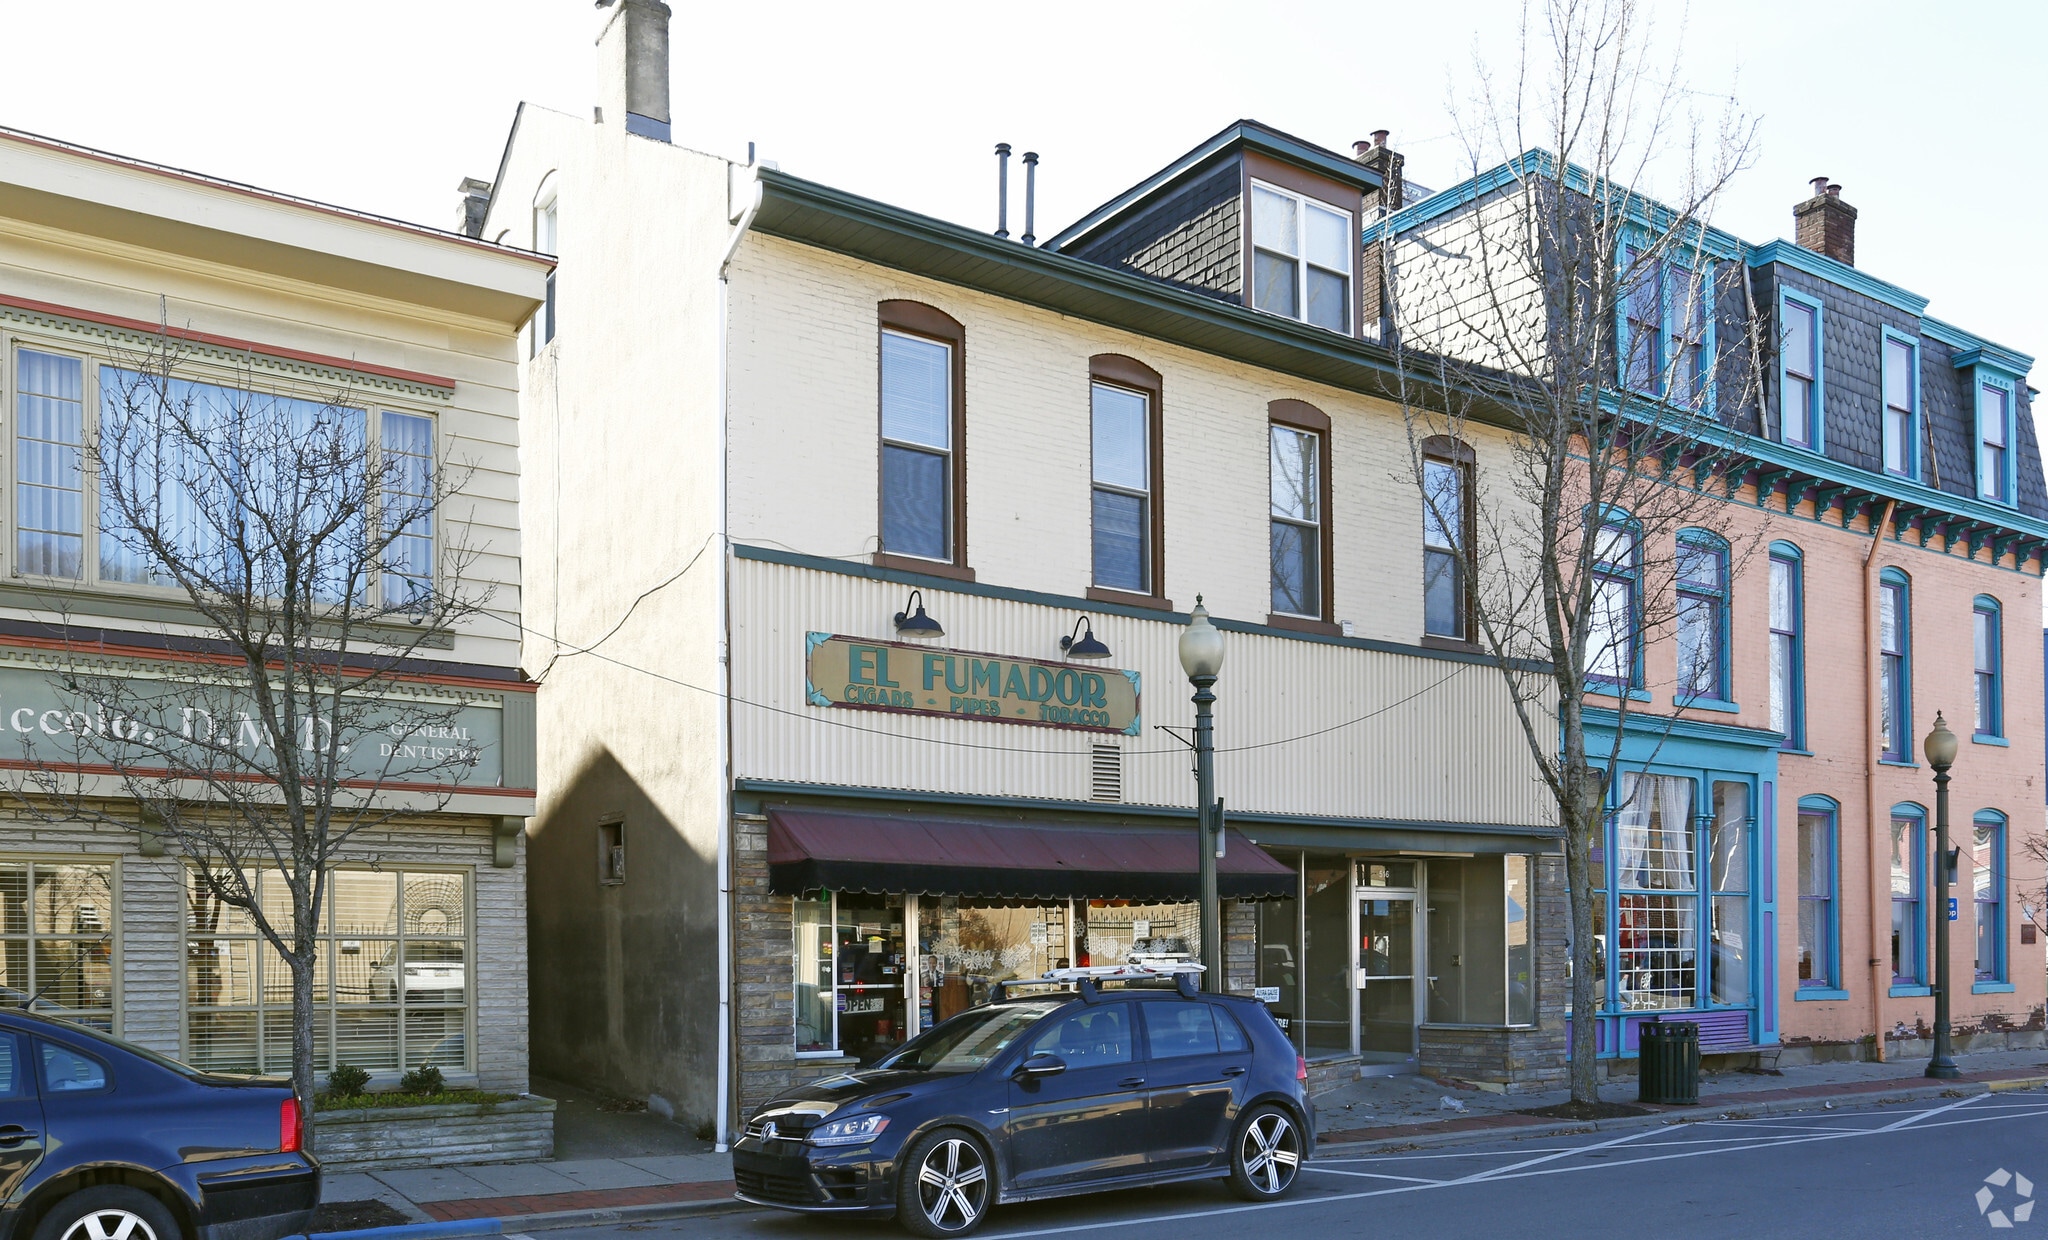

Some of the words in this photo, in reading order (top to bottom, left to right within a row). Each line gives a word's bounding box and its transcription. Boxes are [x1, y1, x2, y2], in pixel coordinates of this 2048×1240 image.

[849, 645, 899, 688] EL
[923, 653, 1107, 708] FUMADOR
[844, 684, 914, 708] CIGARS
[950, 696, 1000, 717] PIPES
[1040, 704, 1110, 727] TOBACCO
[391, 722, 471, 740] GENERAL
